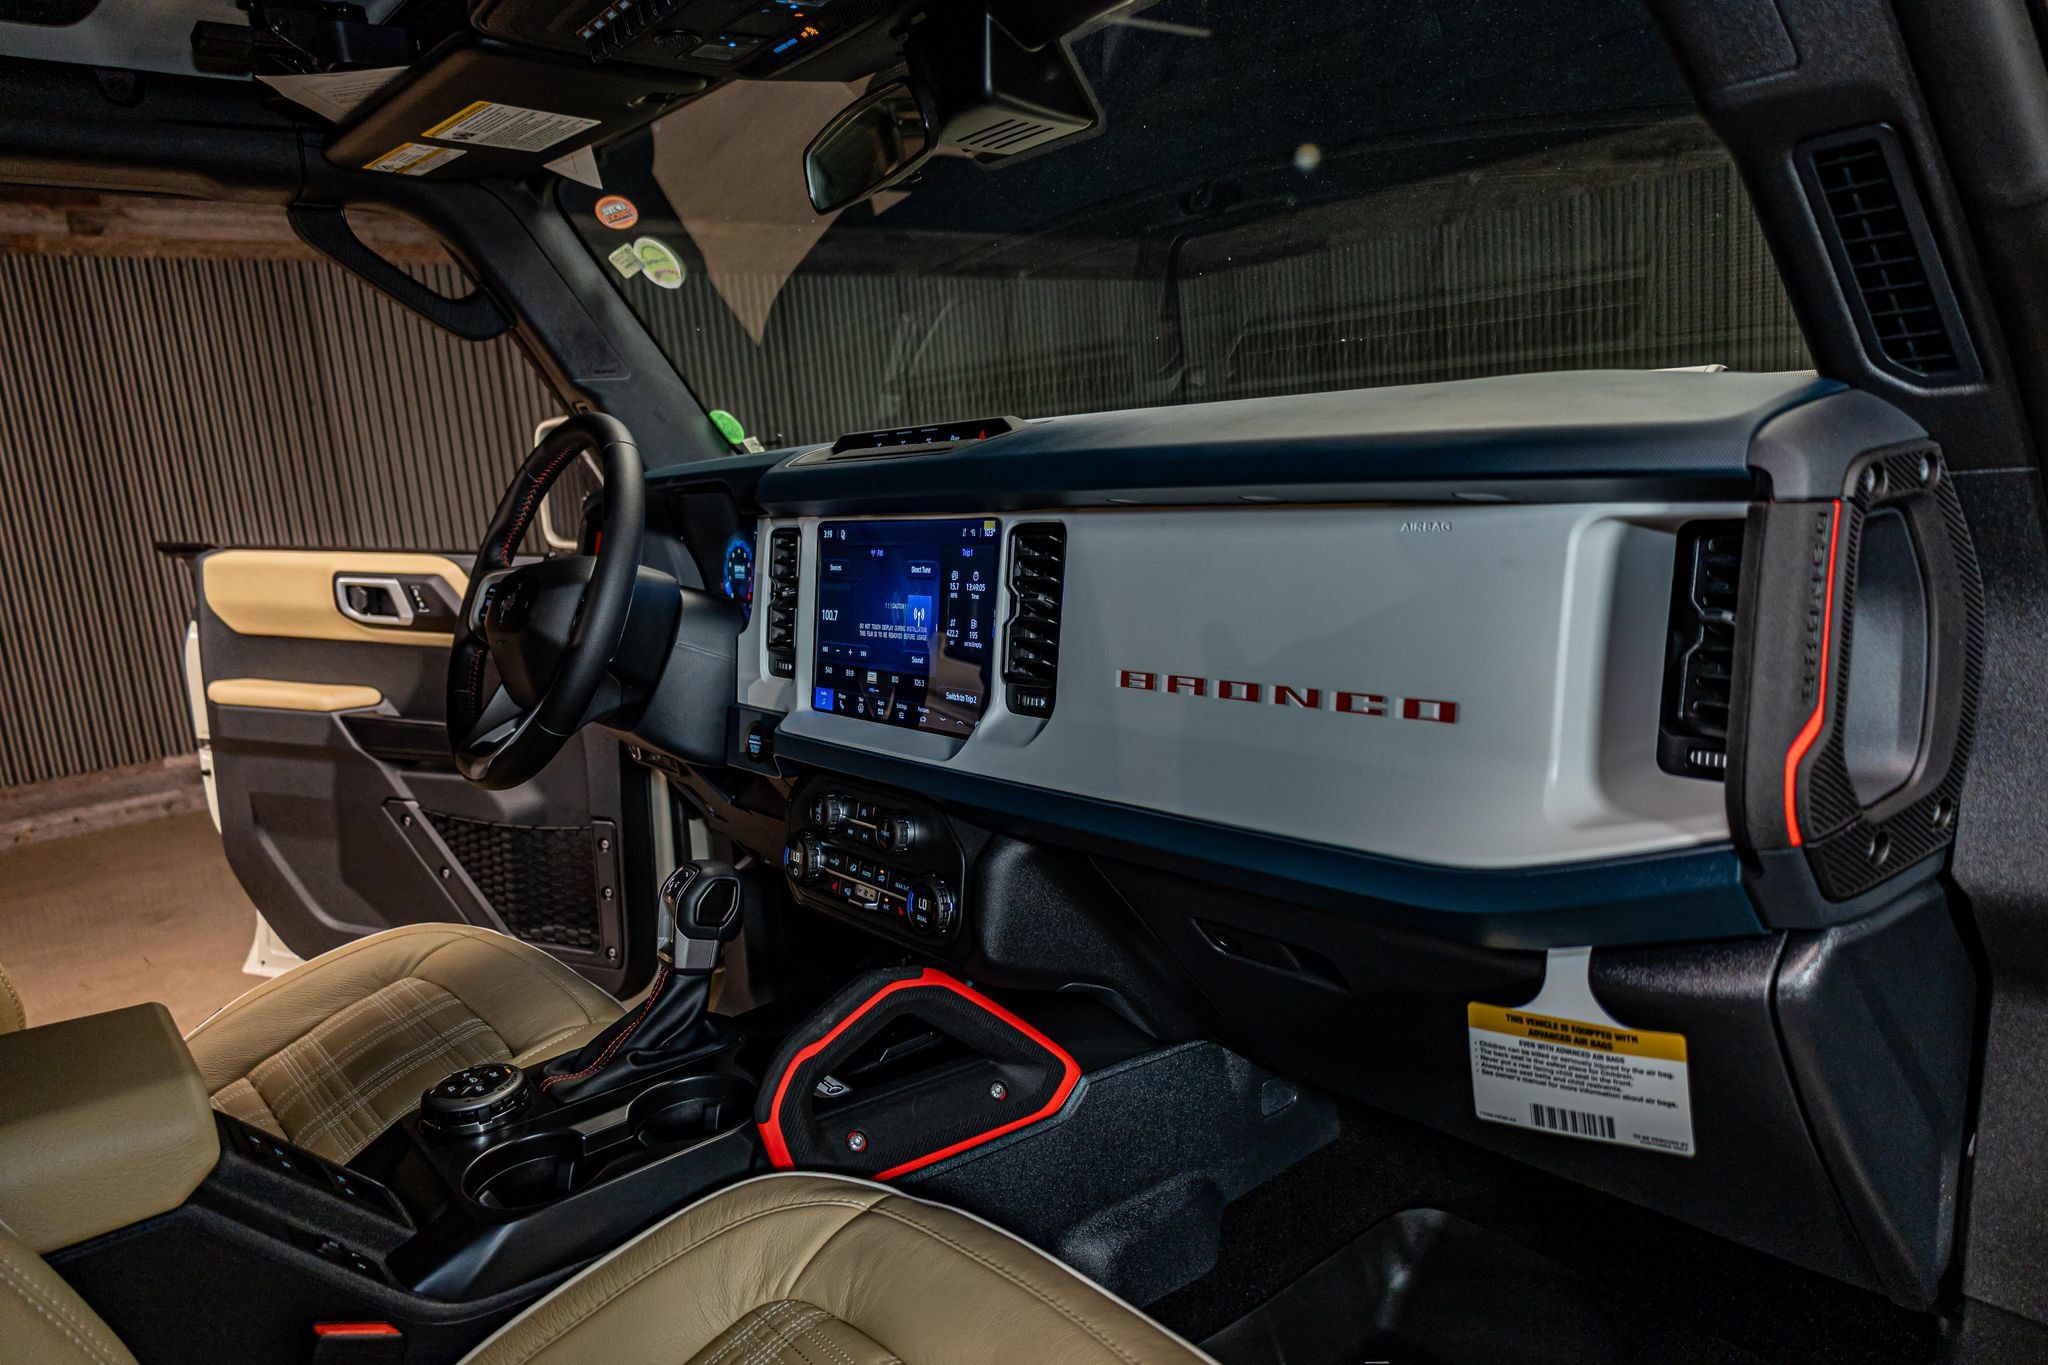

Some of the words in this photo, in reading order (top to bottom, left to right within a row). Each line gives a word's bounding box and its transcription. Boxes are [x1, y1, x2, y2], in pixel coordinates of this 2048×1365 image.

[1401, 521, 1452, 532] AIRBAG
[822, 608, 838, 621] 100.7
[969, 631, 978, 640] 195
[912, 656, 924, 664] Sound
[946, 692, 959, 701] Switch
[965, 694, 973, 704] Trip
[1115, 669, 1459, 724] BRONCO
[919, 898, 927, 910] LO
[1506, 1014, 1523, 1024] THIS
[1526, 1017, 1558, 1030] VEHICLE
[1571, 1025, 1612, 1040] EQUIPPED
[1614, 1033, 1638, 1044] WITH
[1528, 1028, 1571, 1042] ADVANCED
[1574, 1038, 1588, 1046] AIR
[1590, 1040, 1613, 1050] BAGS
[1479, 1040, 1506, 1051] Children
[1531, 1050, 1550, 1059] killed
[1560, 1056, 1592, 1067] seriously
[1593, 1062, 1619, 1072] injured
[1621, 1065, 1630, 1074] by
[1658, 1071, 1674, 1080] bag.
[1493, 1050, 1508, 1058] back
[1511, 1053, 1524, 1061] seat
[1534, 1057, 1544, 1065] the
[1546, 1060, 1566, 1069] safest
[1568, 1063, 1587, 1074] place
[1589, 1067, 1598, 1076] for
[1519, 1040, 1536, 1048] EVEN
[1538, 1043, 1554, 1052] WITH
[1556, 1047, 1590, 1059] ADVANCED
[1592, 1052, 1604, 1060] AIR
[1606, 1054, 1624, 1064] BAGS
[1480, 1055, 1499, 1063] Never
[1533, 1064, 1554, 1075] facing
[1556, 1068, 1573, 1078] child
[1574, 1072, 1590, 1081] seat
[1481, 1062, 1504, 1072] Always
[1519, 1068, 1533, 1077] seat
[1535, 1071, 1551, 1080] belts
[1553, 1074, 1565, 1083] and
[1568, 1077, 1585, 1086] child
[1482, 1069, 1493, 1077] See
[1495, 1072, 1520, 1081] owner's
[1522, 1076, 1547, 1086] manual
[1548, 1080, 1558, 1088] for
[1560, 1084, 1577, 1092] more
[1579, 1087, 1620, 1100] information
[1622, 1094, 1644, 1103] about
